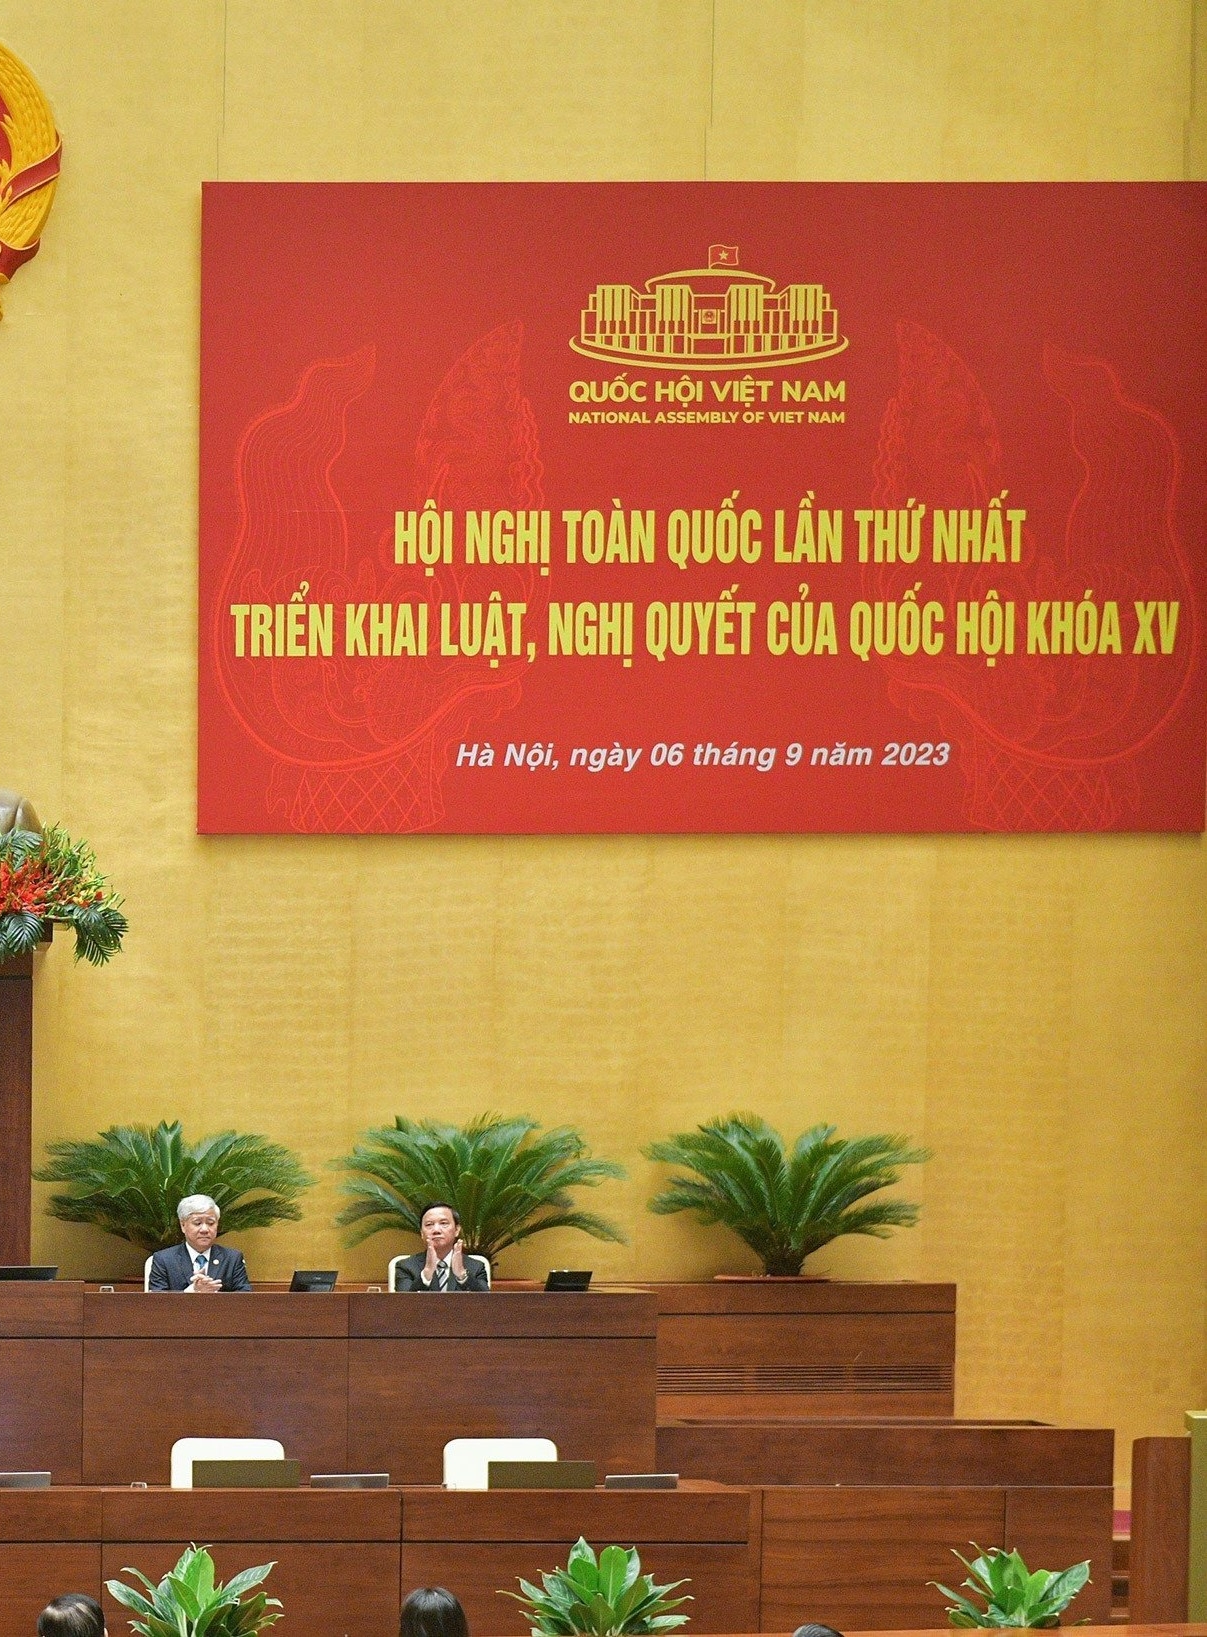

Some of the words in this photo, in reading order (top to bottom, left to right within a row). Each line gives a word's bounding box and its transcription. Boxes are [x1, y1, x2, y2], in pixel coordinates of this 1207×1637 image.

[569, 373, 646, 402] QUỐC
[655, 375, 703, 407] HỘI
[711, 375, 773, 407] VIỆT
[782, 381, 845, 401] NAM
[569, 412, 650, 423] NATIONAL
[655, 412, 738, 423] ASSEMBLY
[743, 412, 764, 423] OF
[769, 412, 804, 423] VIET
[809, 412, 845, 423] NAM
[395, 499, 453, 576] HỘI
[466, 510, 550, 576] NGHỊ
[562, 498, 655, 564] TOÀN
[668, 490, 762, 569] QUỐC
[775, 491, 842, 562] LẦN
[854, 498, 925, 563] THỨ
[933, 490, 1026, 562] NHẤT
[231, 581, 333, 657] TRIỂN
[346, 603, 428, 656] KHAI
[441, 591, 535, 668] LUẬT,
[549, 602, 633, 667] NGHỊ
[646, 584, 756, 661] QUYẾT
[767, 583, 838, 655] CỦA
[850, 582, 944, 661] QUỐC
[957, 590, 1014, 666] HỘI
[1027, 590, 1121, 654] KHÓA
[1134, 602, 1178, 653] XV
[456, 743, 494, 766] Hà
[504, 743, 558, 771] Nội,
[570, 742, 642, 772] ngày
[651, 743, 684, 766] 06
[694, 742, 776, 771] tháng
[786, 743, 802, 765] 9
[811, 743, 872, 765] năm
[882, 743, 950, 765] 2023
